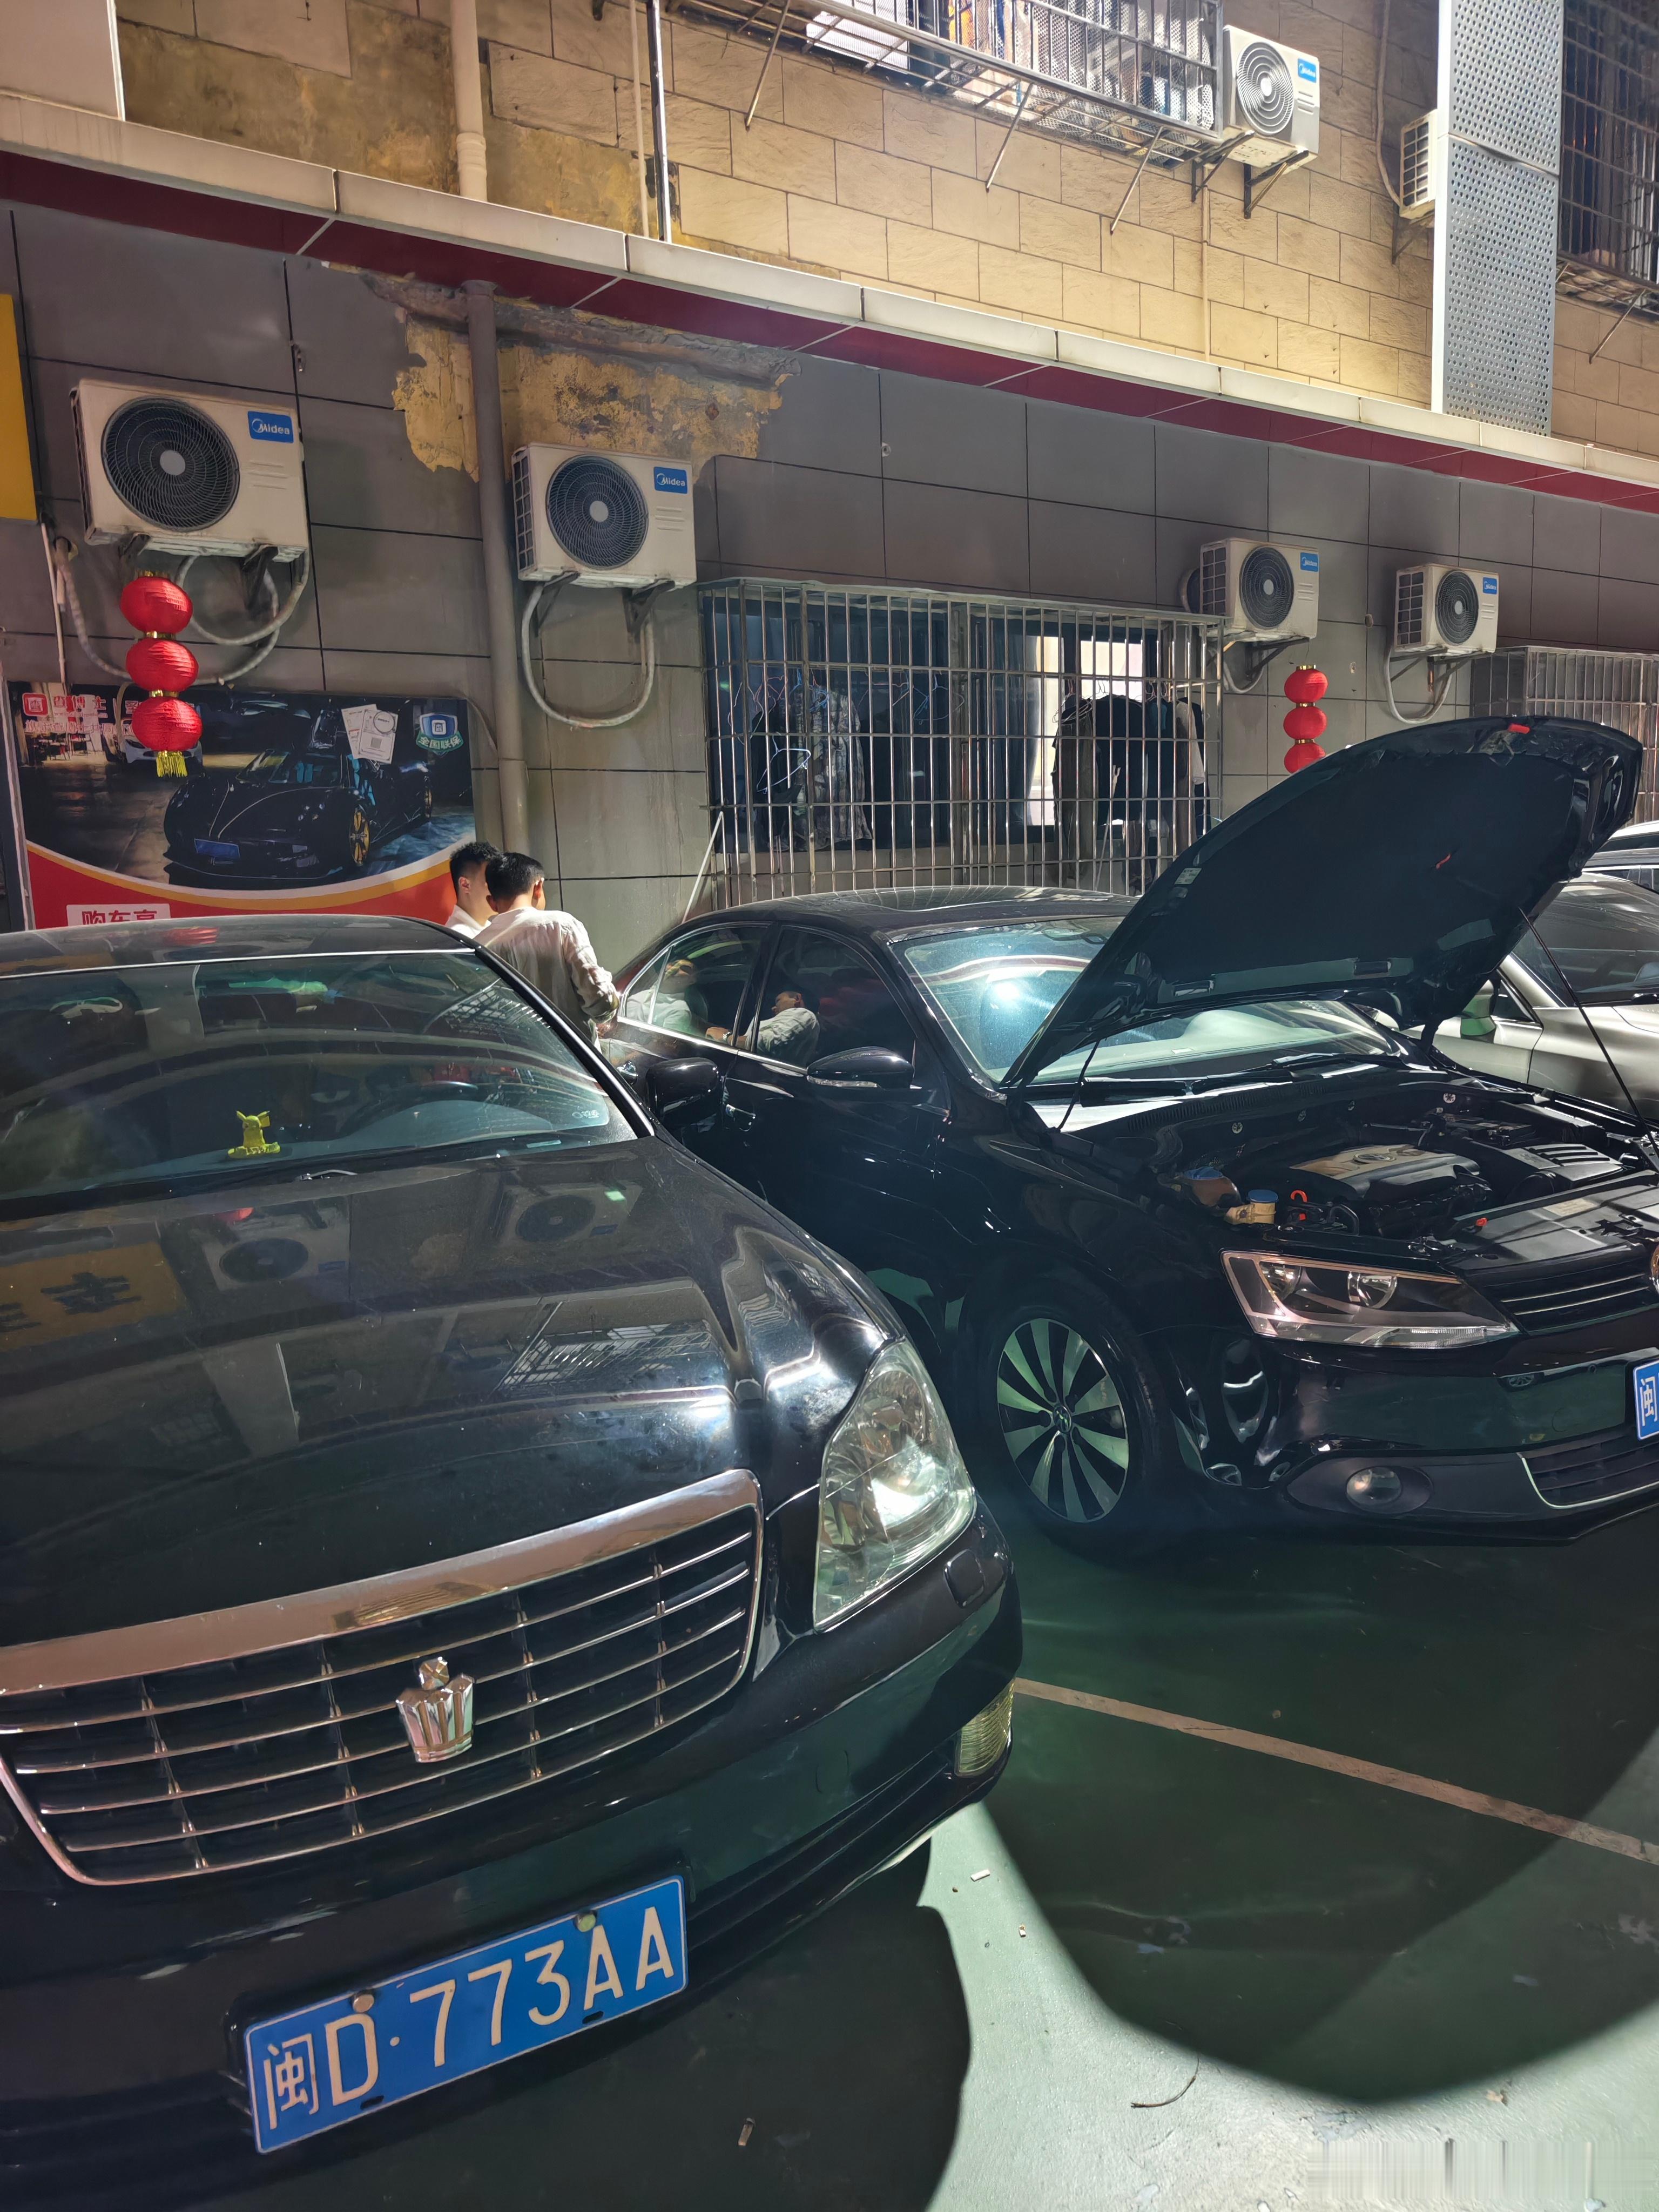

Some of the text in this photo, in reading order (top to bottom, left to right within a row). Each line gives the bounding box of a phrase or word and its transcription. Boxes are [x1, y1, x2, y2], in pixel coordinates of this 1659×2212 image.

[252, 419, 289, 435] Midea
[657, 473, 685, 487] Midea
[419, 736, 461, 750] 全国联保
